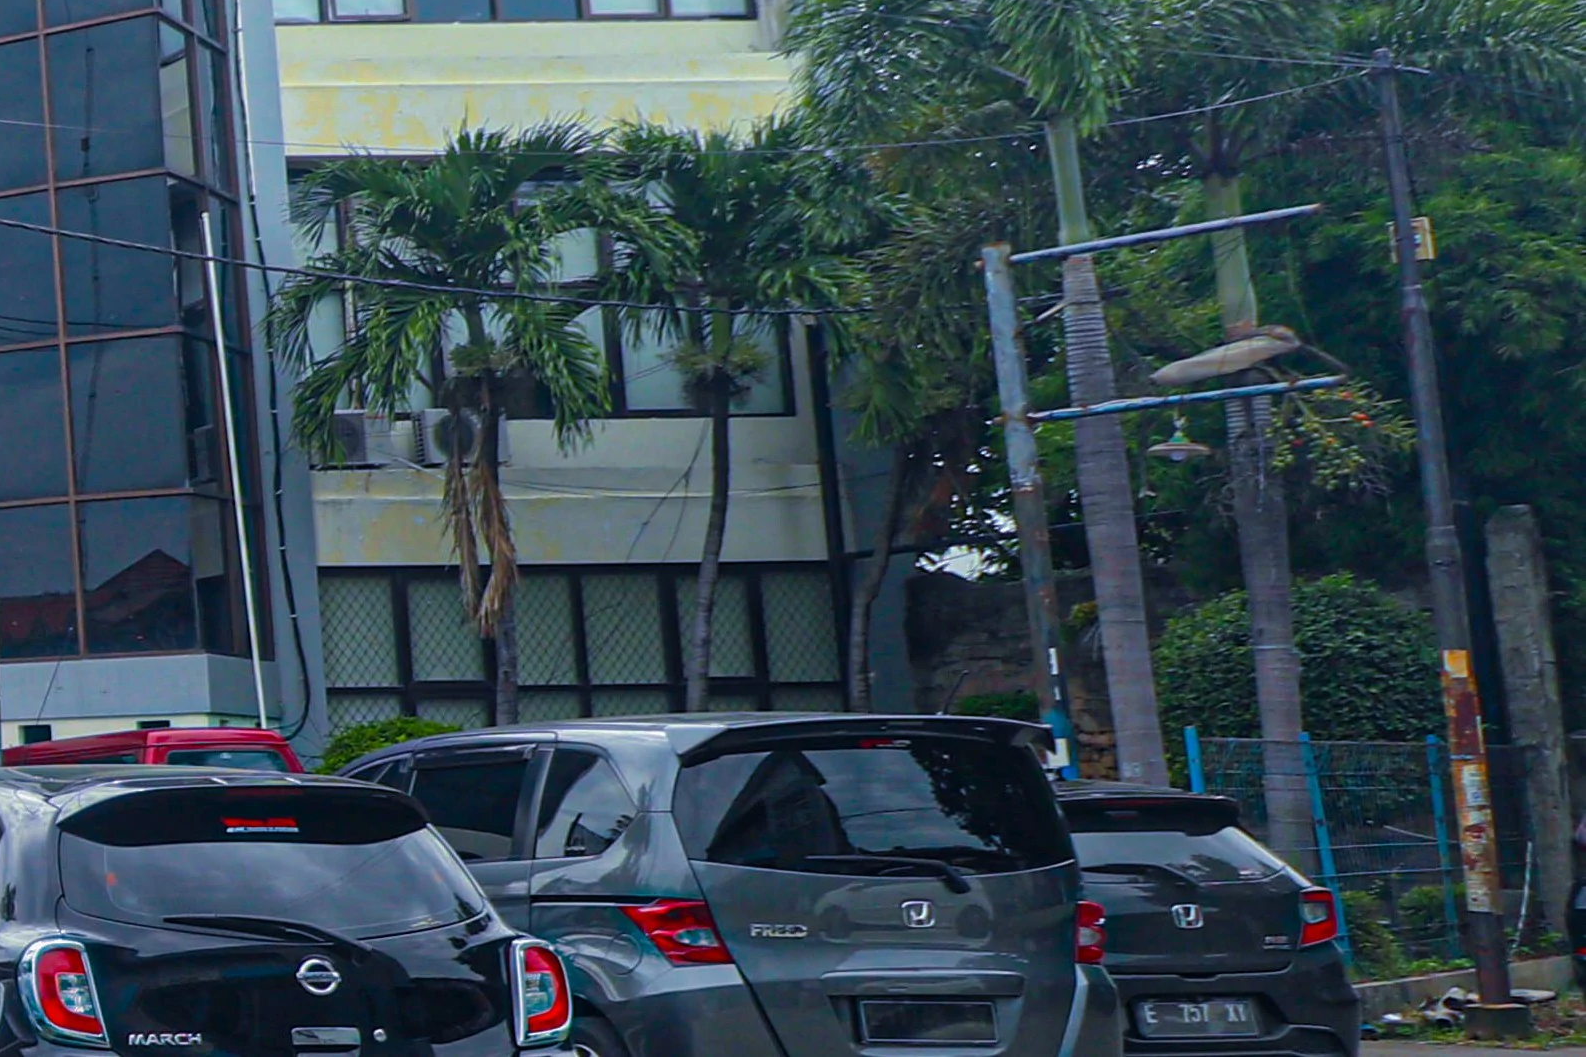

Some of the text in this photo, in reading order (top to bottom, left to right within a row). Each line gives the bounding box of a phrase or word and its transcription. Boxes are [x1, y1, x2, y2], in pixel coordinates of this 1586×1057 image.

[750, 923, 808, 938] FREED
[1144, 1004, 1158, 1023] E
[128, 1032, 202, 1046] MARCH
